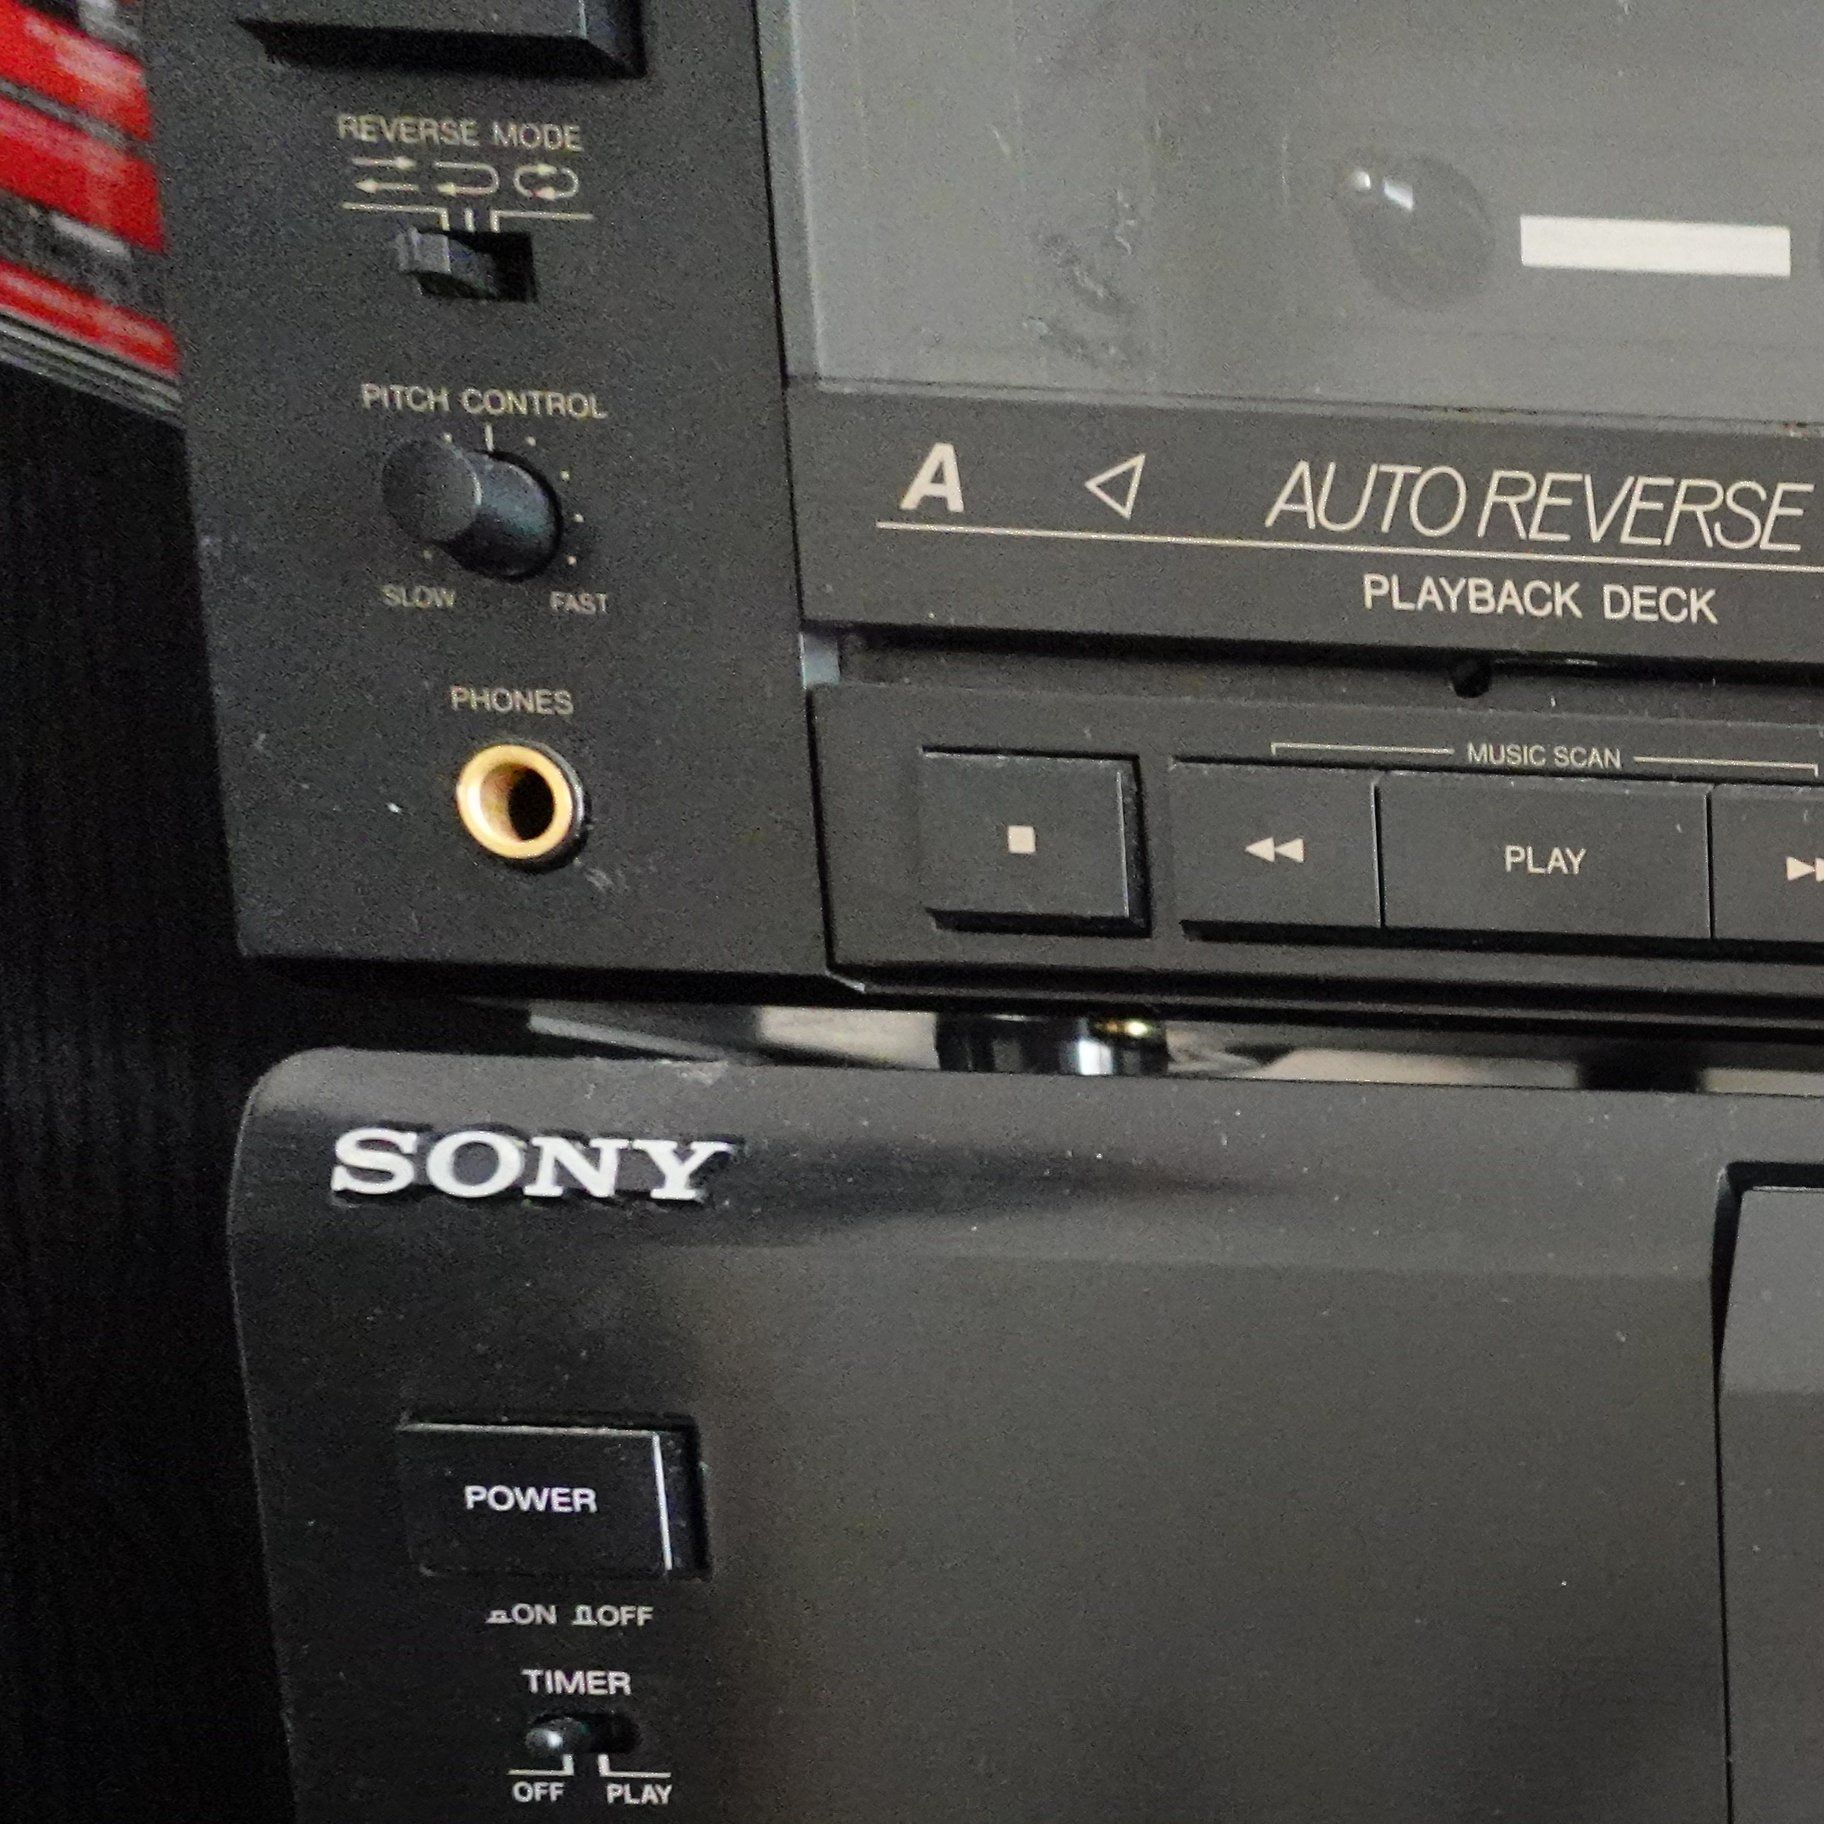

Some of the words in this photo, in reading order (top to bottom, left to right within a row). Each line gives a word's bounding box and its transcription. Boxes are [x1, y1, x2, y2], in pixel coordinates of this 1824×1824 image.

[338, 115, 480, 148] REVERSE
[494, 123, 584, 153] MODE
[361, 383, 449, 413] PITCH
[462, 387, 606, 420] CONTROL
[900, 444, 964, 511] A
[1266, 461, 1468, 539] AUTO
[1473, 469, 1814, 553] REVERSE
[382, 586, 456, 609] SLOW
[550, 591, 608, 615] FAST
[1364, 575, 1581, 618] PLAYBACK
[1603, 583, 1717, 624] DECK
[451, 687, 574, 716] PHONES
[1467, 741, 1545, 767] MUSIC
[1555, 747, 1621, 769] SCAN
[1505, 845, 1584, 874] PLAY
[332, 1128, 736, 1201] SONY
[466, 1486, 597, 1513] POWER
[511, 1604, 556, 1625] ON
[597, 1605, 652, 1626] OFF
[522, 1670, 631, 1695] TIMER
[512, 1781, 563, 1802] OFF
[607, 1782, 672, 1805] PLAY
